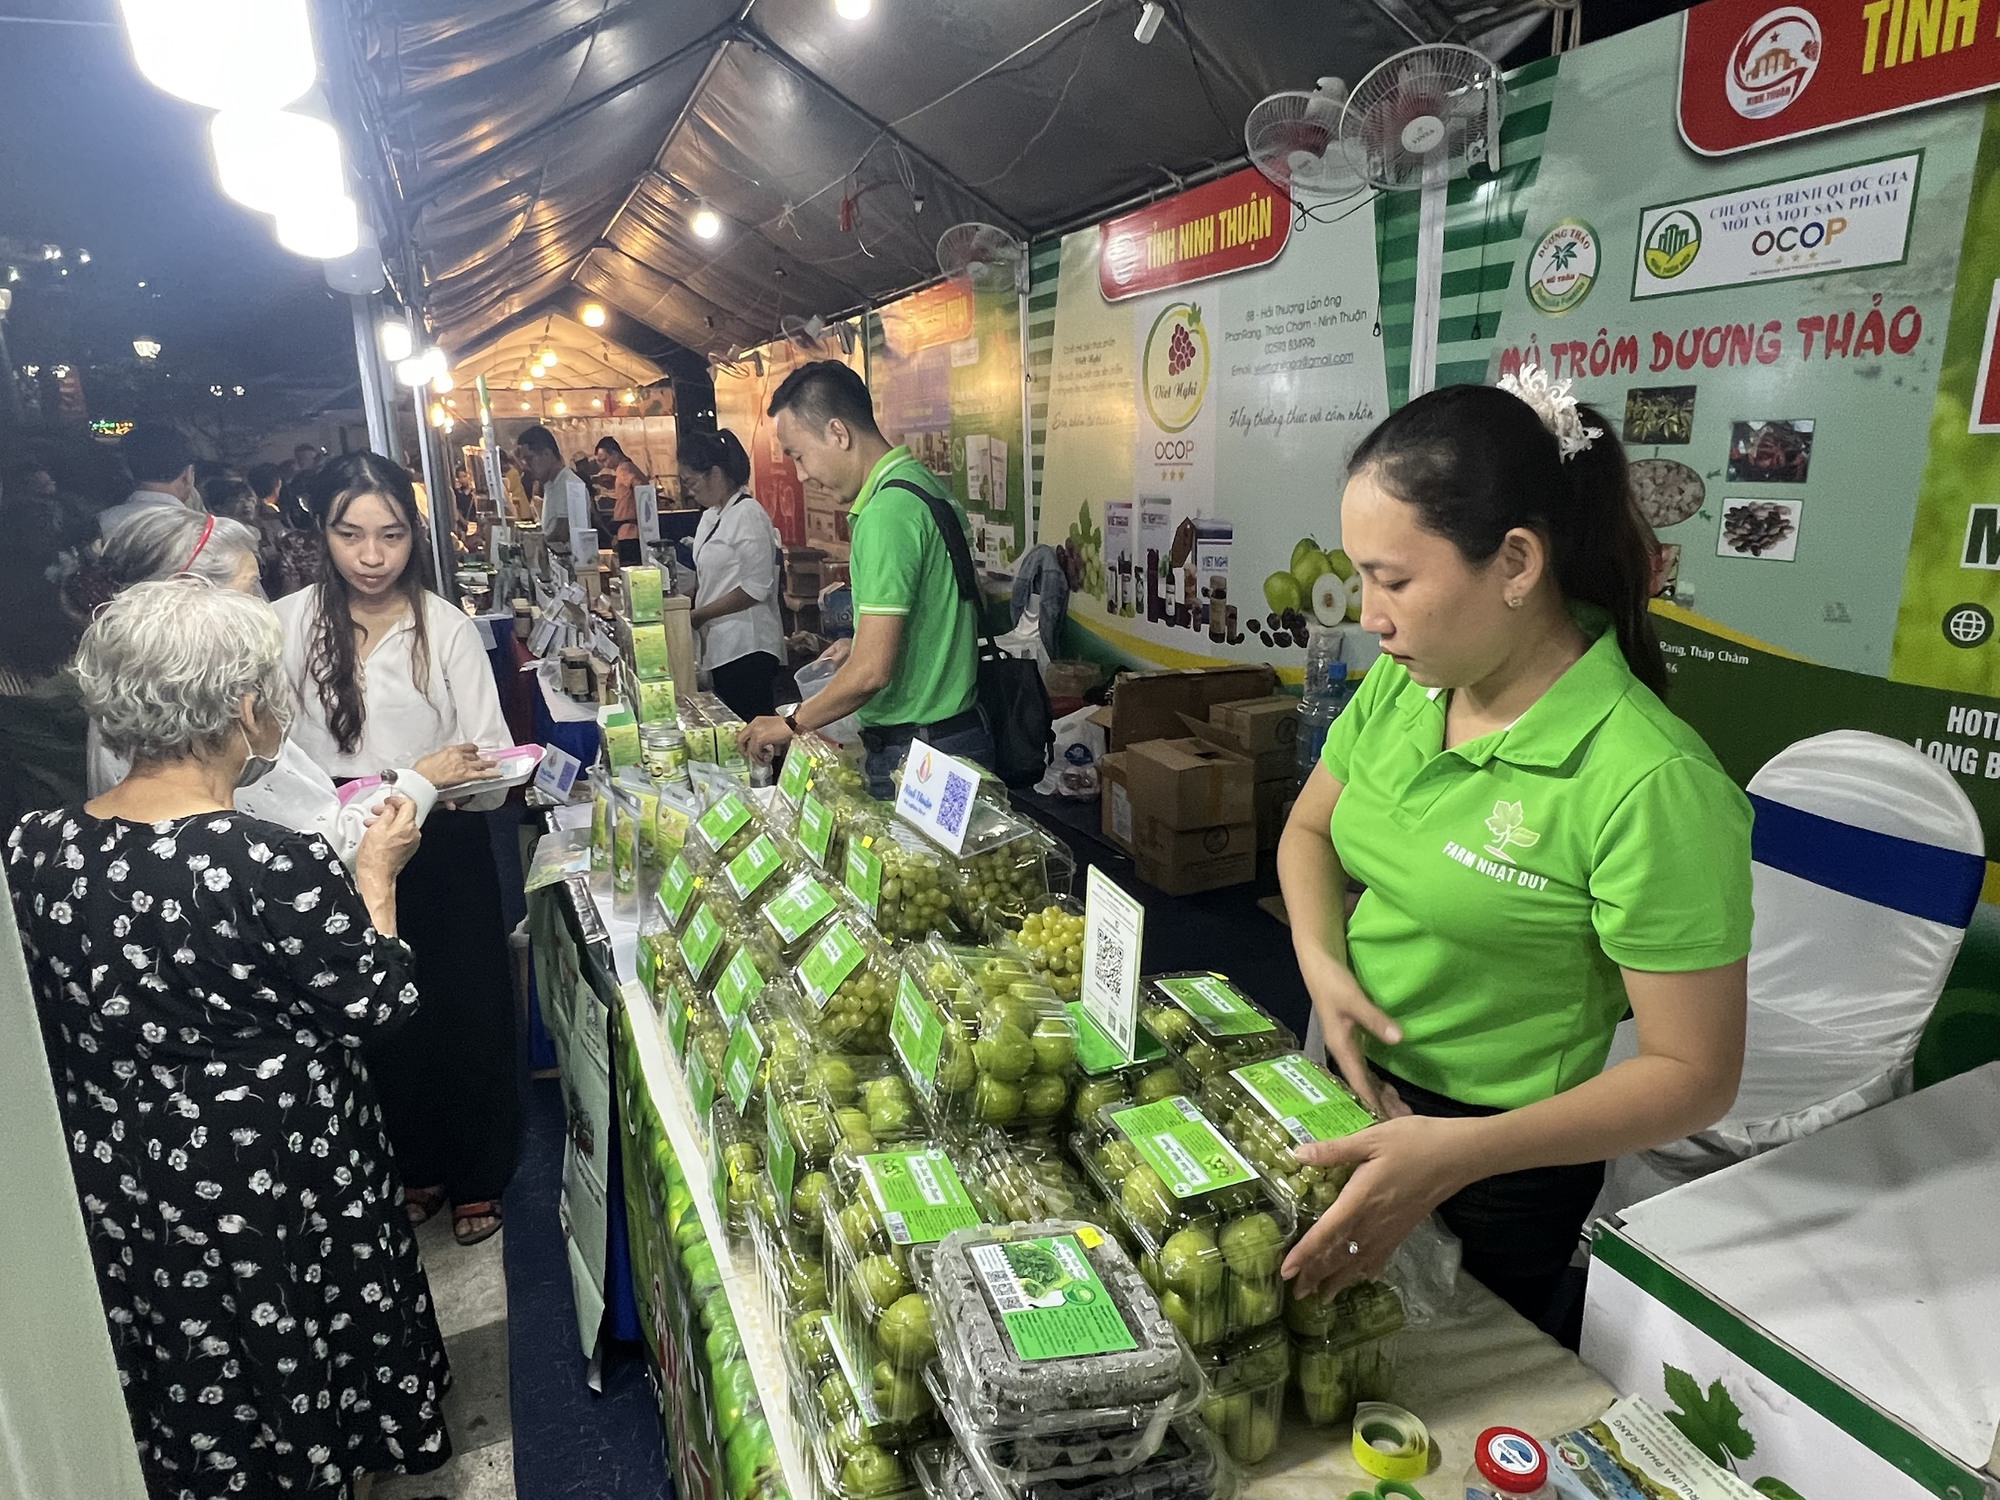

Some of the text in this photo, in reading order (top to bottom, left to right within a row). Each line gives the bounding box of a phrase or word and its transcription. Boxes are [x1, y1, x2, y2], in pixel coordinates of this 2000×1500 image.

[1710, 170, 1908, 220] CHƯƠNG TRÌNH QUỐC GIA
[1146, 192, 1272, 270] TỈNH NINH THUẬN
[1752, 217, 1848, 256] OCOP
[1275, 303, 1305, 316] Thượng
[1318, 316, 1337, 328] Ninh
[1340, 310, 1367, 322] Thuận
[1550, 328, 1638, 379] TRÔM
[1648, 320, 1782, 372] DƯƠNG
[1797, 293, 1922, 360] THẢO
[1154, 440, 1194, 460] OCOP
[1690, 645, 1715, 662] Tháp
[1718, 650, 1749, 664] Chàm
[1442, 840, 1477, 868] FARM
[1517, 871, 1549, 892] DUY
[1612, 1419, 1642, 1444] RANG
[1638, 1443, 1666, 1468] PHAN
